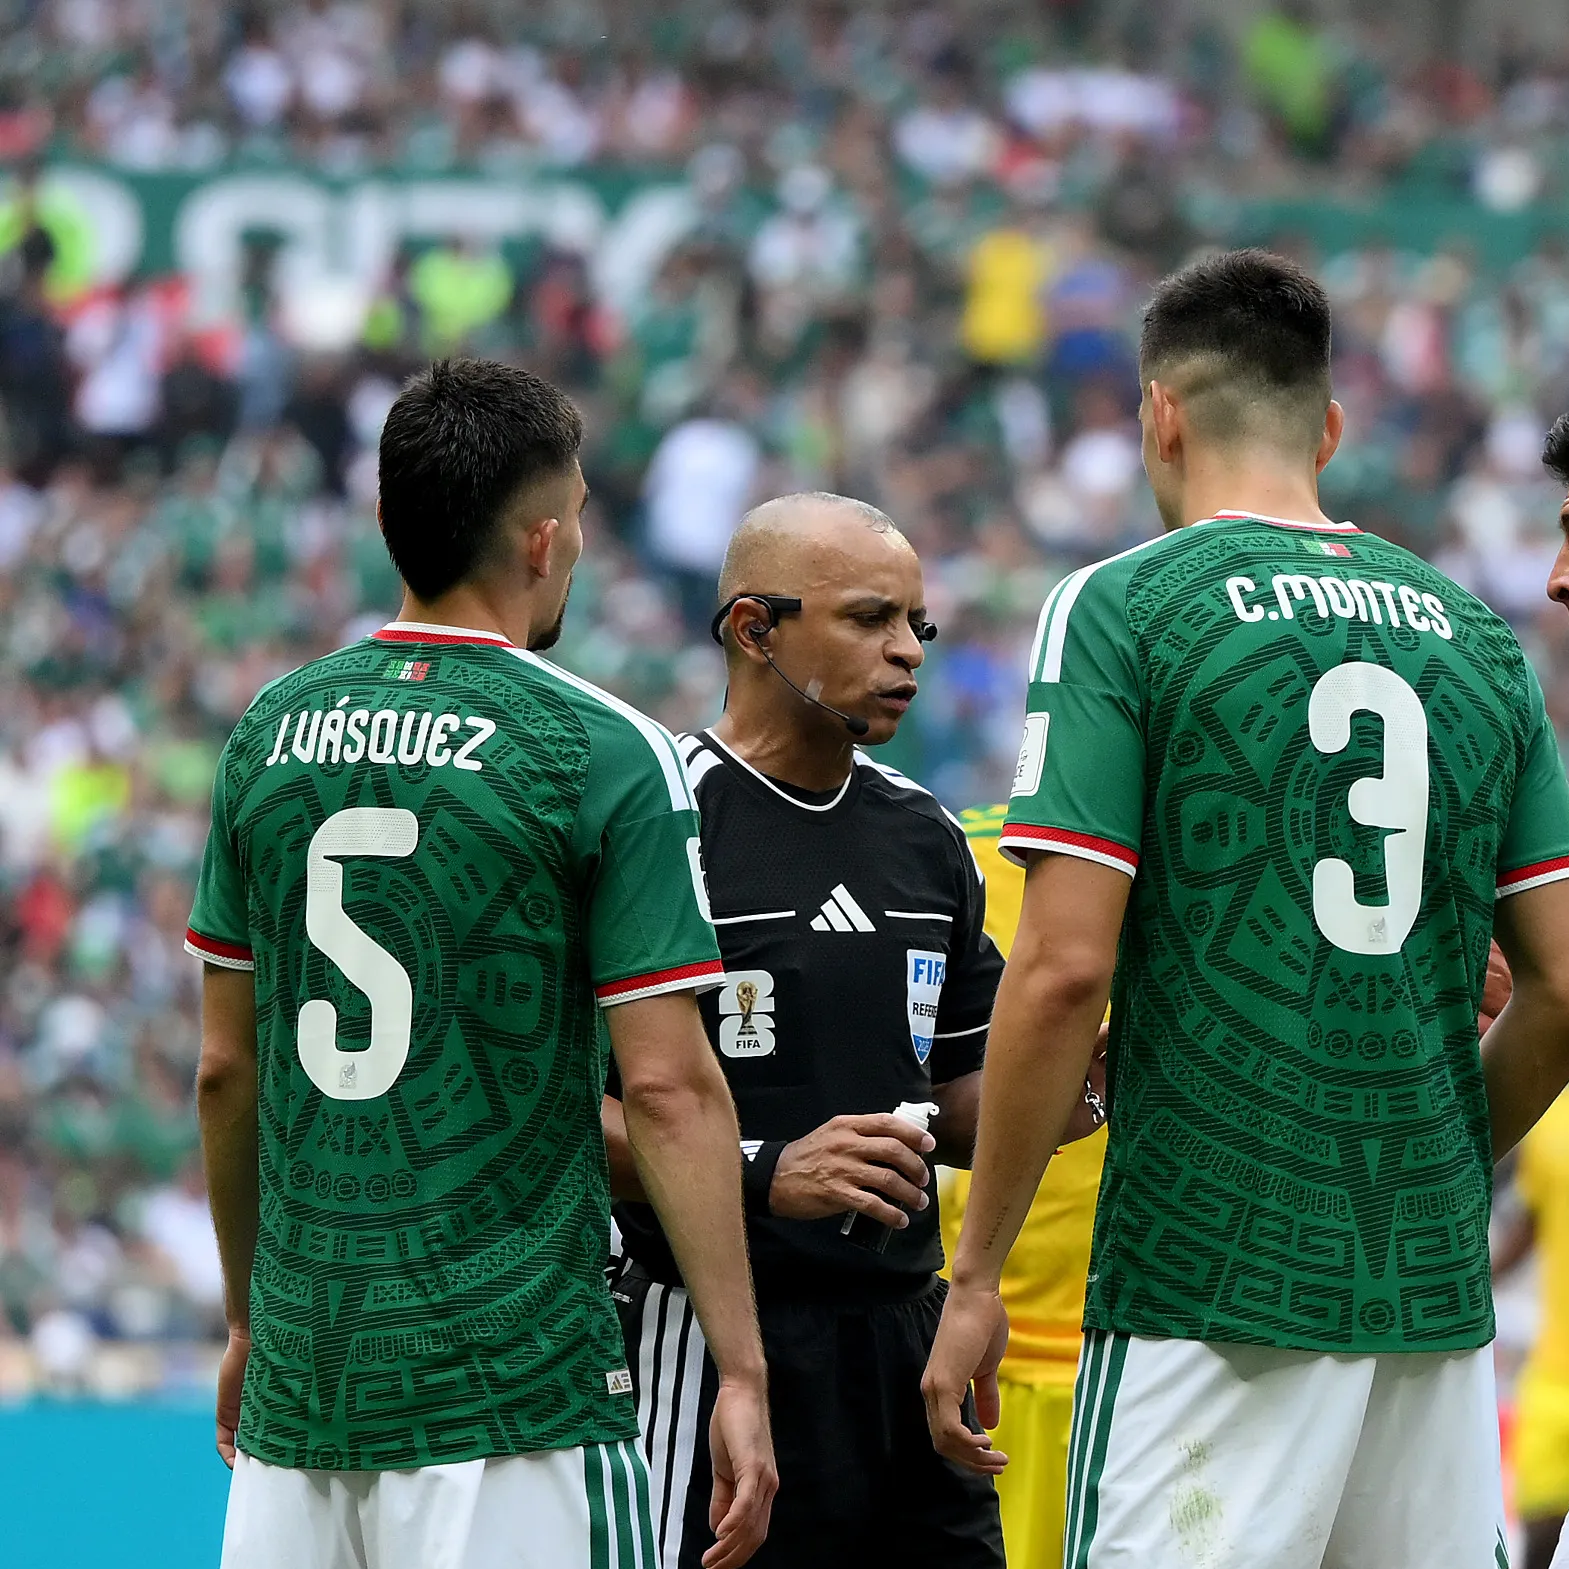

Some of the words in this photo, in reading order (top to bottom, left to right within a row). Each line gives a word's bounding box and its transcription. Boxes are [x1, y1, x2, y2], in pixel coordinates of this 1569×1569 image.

[1225, 574, 1452, 640] C.MONTES
[266, 696, 497, 772] J.VÁSQUEZ
[1308, 661, 1430, 956] 3
[297, 807, 419, 1101] 5
[736, 1039, 761, 1050] FIFA
